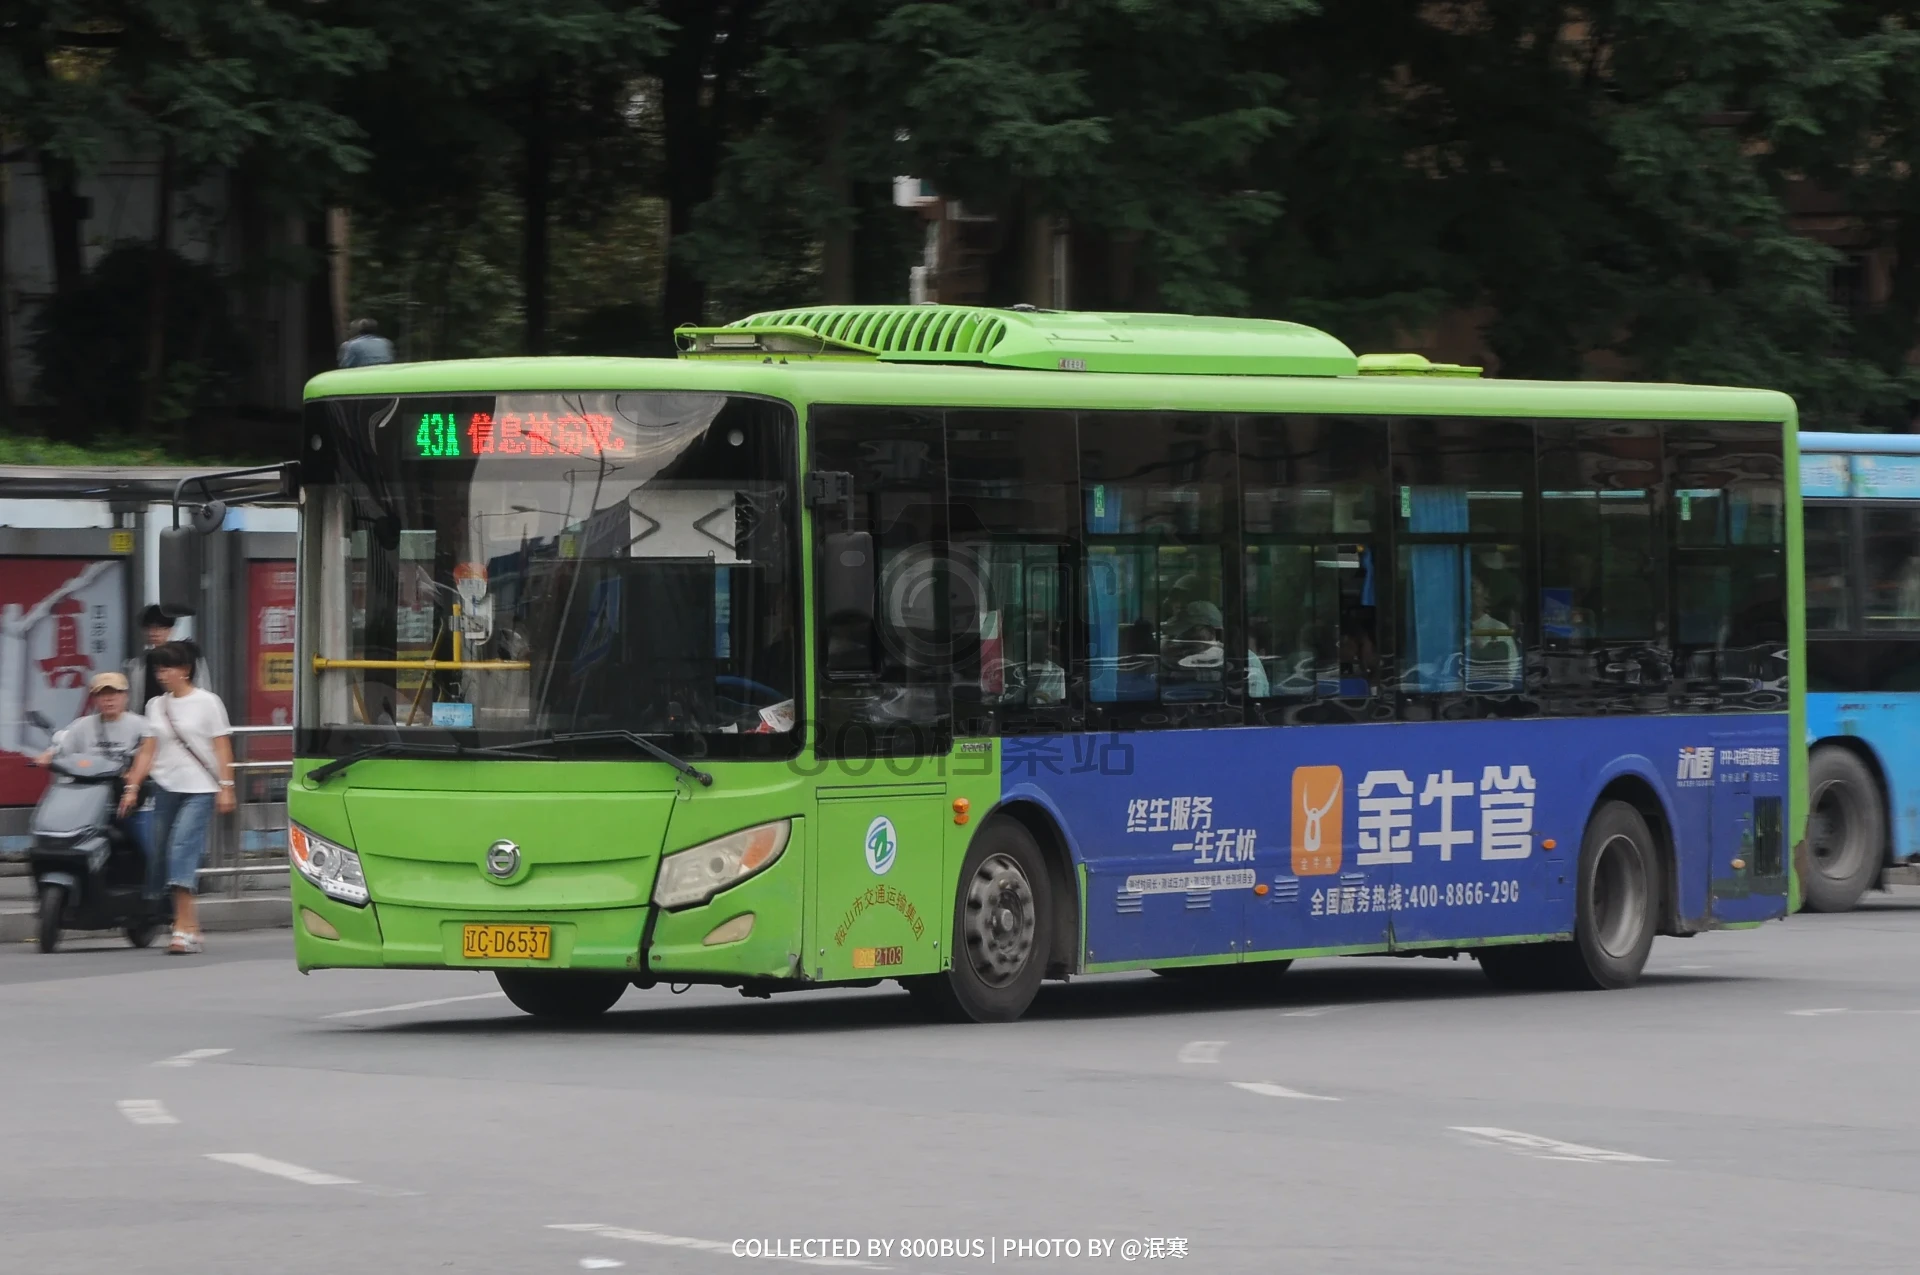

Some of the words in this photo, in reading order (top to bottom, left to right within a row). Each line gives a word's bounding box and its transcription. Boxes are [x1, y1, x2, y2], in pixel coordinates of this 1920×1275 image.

[416, 413, 459, 456] 43A
[1126, 796, 1213, 833] 终生服务
[1357, 765, 1536, 865] 金牛管
[1172, 828, 1257, 864] 一生无忧
[875, 947, 903, 966] 2103
